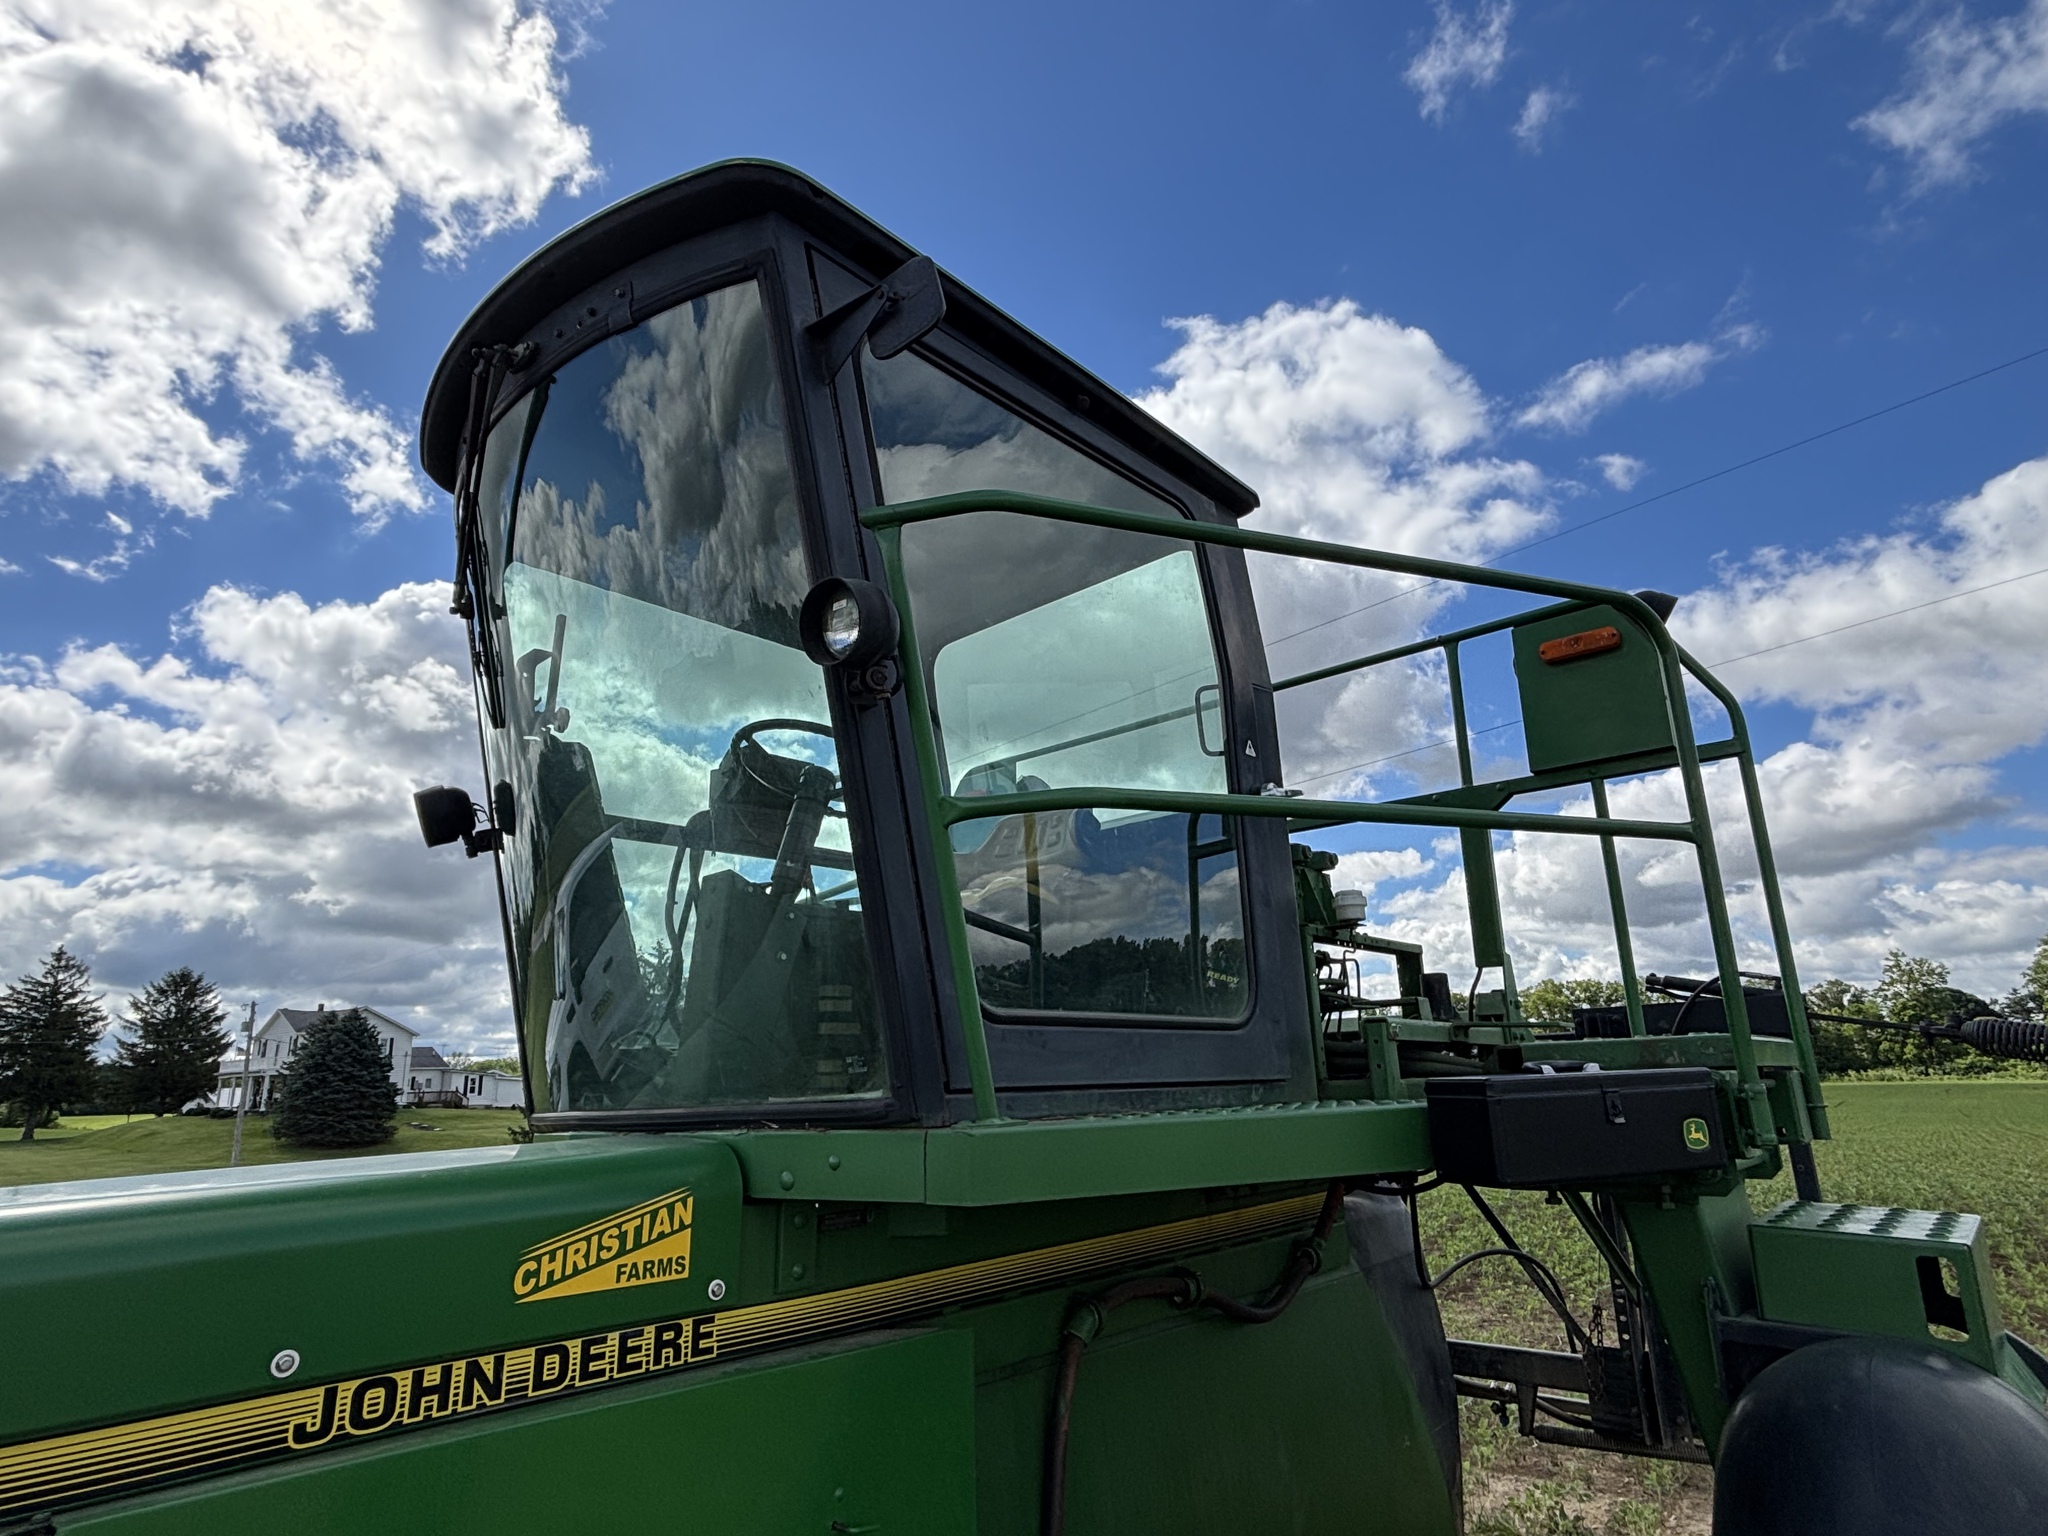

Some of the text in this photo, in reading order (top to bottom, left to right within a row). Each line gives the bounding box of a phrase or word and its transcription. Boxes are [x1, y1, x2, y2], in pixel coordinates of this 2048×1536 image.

[1206, 971, 1240, 984] READY
[514, 1197, 692, 1295] CHRISTIAN
[616, 1256, 686, 1284] FARMS
[289, 1315, 717, 1448] JOHN DEERE
